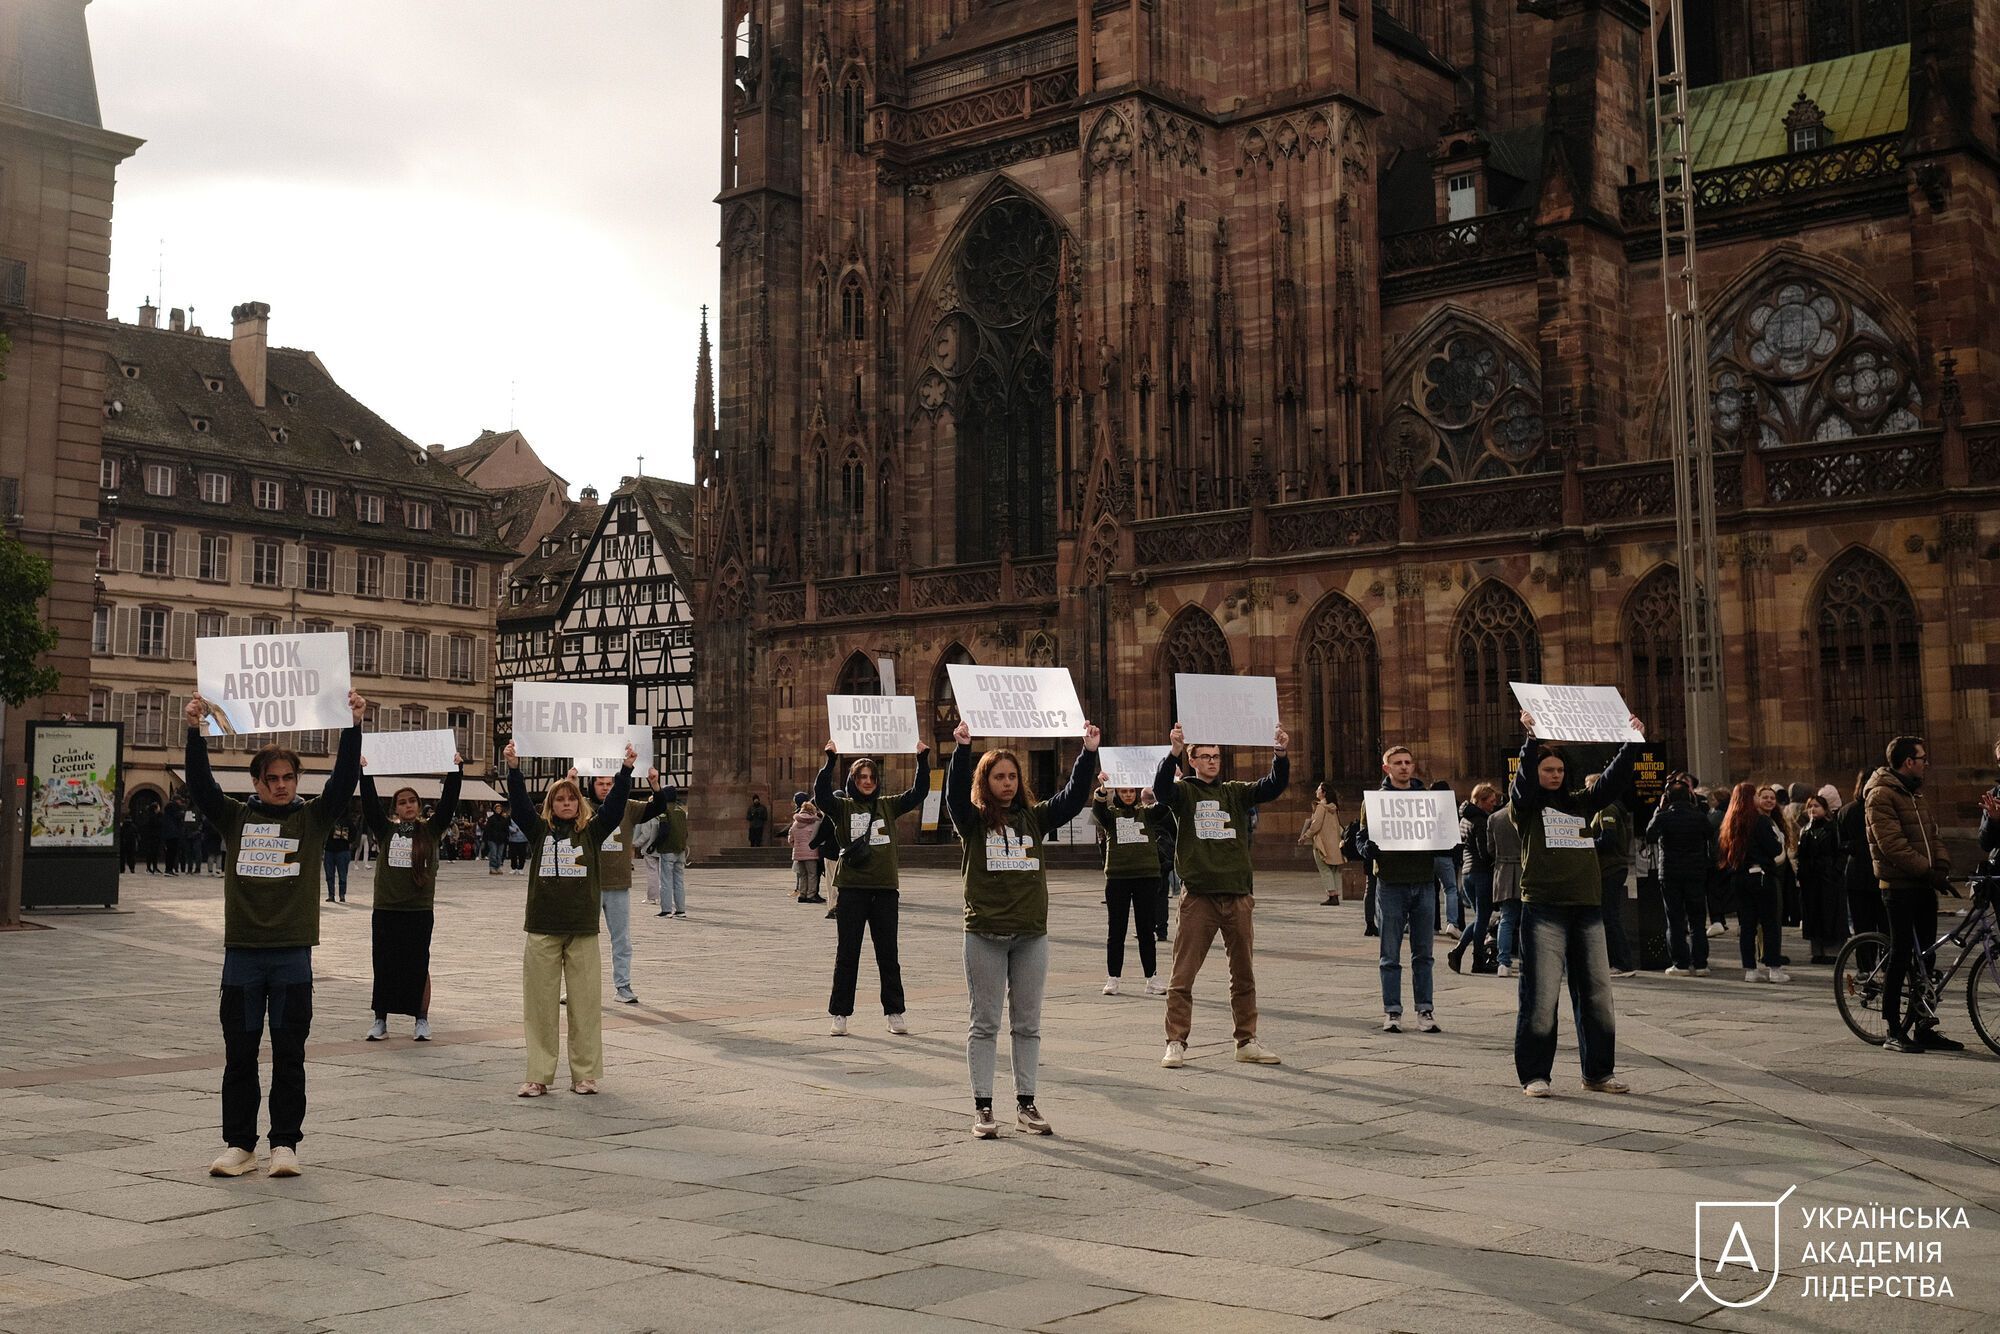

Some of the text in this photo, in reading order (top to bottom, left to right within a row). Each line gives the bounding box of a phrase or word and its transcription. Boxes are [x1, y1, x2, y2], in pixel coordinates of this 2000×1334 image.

[240, 641, 302, 669] LOOK
[223, 670, 320, 700] AROUND
[975, 674, 1038, 692] DO YOU
[1544, 686, 1588, 700] WHAT
[852, 697, 893, 714] DON'T
[988, 692, 1037, 710] HEAR
[1525, 698, 1624, 714] IS ESSENTIAL
[249, 700, 296, 728] YOU
[514, 701, 624, 734] HEAR IT.
[966, 710, 1068, 728] THE MUSIC?
[1534, 712, 1628, 728] IS INVISIBLE
[836, 715, 912, 734] JUST HEAR,
[852, 732, 899, 749] LISTEN
[1545, 726, 1567, 740] TO
[1566, 727, 1596, 741] THE
[52, 751, 95, 764] Grande
[592, 757, 603, 769] IS
[1642, 752, 1653, 761] THE
[53, 762, 96, 774] Lecture
[1640, 771, 1657, 780] SONG
[254, 826, 270, 834] AM
[1381, 820, 1447, 840] EUROPE
[1554, 828, 1575, 836] LOVE
[1549, 838, 1588, 847] FREEDOM
[250, 852, 277, 862] LOVE
[996, 849, 1020, 858] LOVE
[240, 864, 291, 876] FREEDOM
[990, 860, 1034, 869] FREEDOM
